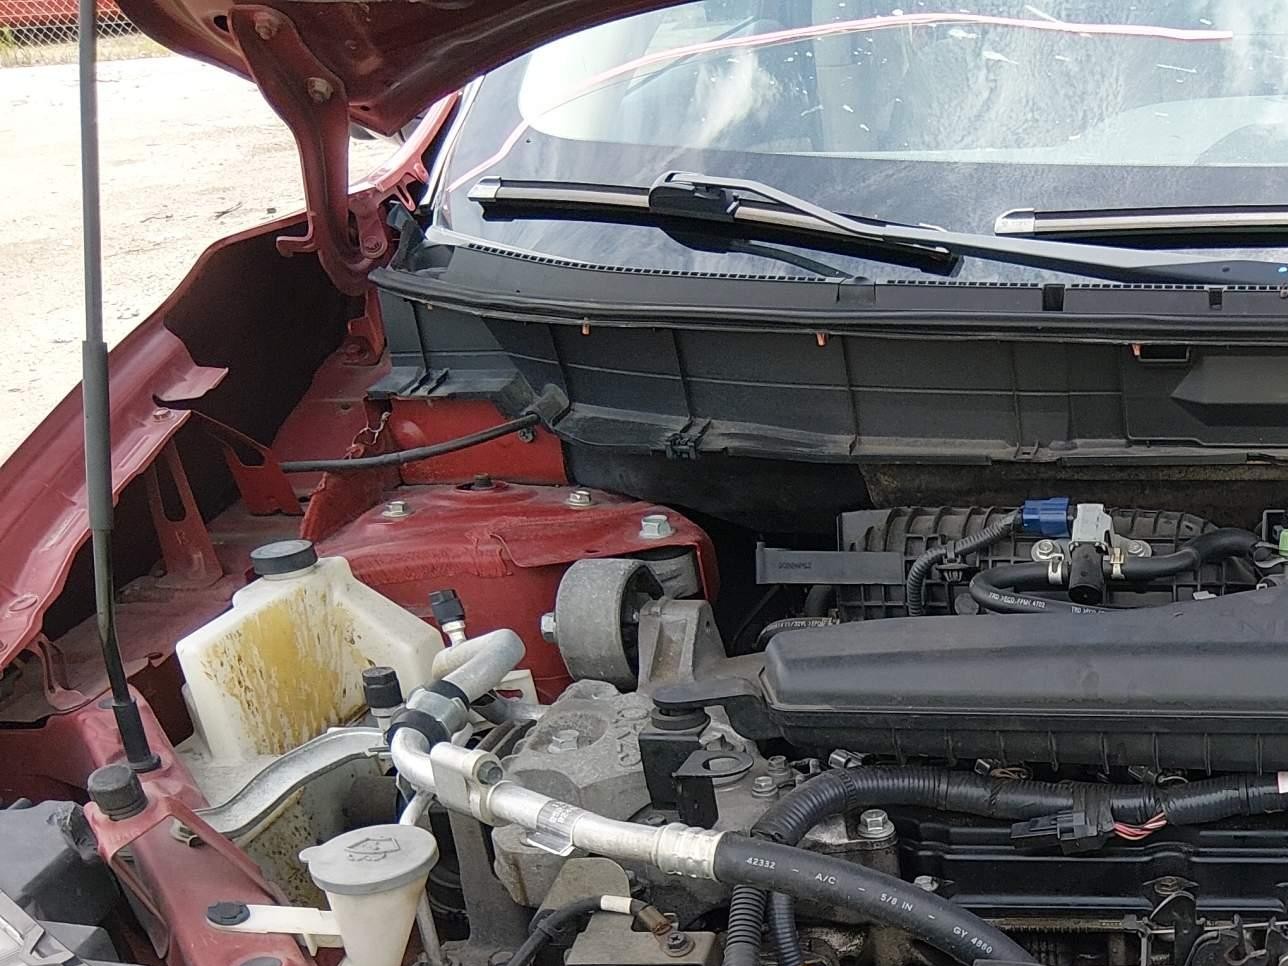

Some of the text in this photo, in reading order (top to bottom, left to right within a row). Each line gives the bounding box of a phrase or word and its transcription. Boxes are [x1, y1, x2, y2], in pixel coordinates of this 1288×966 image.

[746, 857, 776, 869] 42332
[815, 872, 836, 885] A/C
[901, 900, 914, 912] IN
[953, 926, 968, 938] GY
